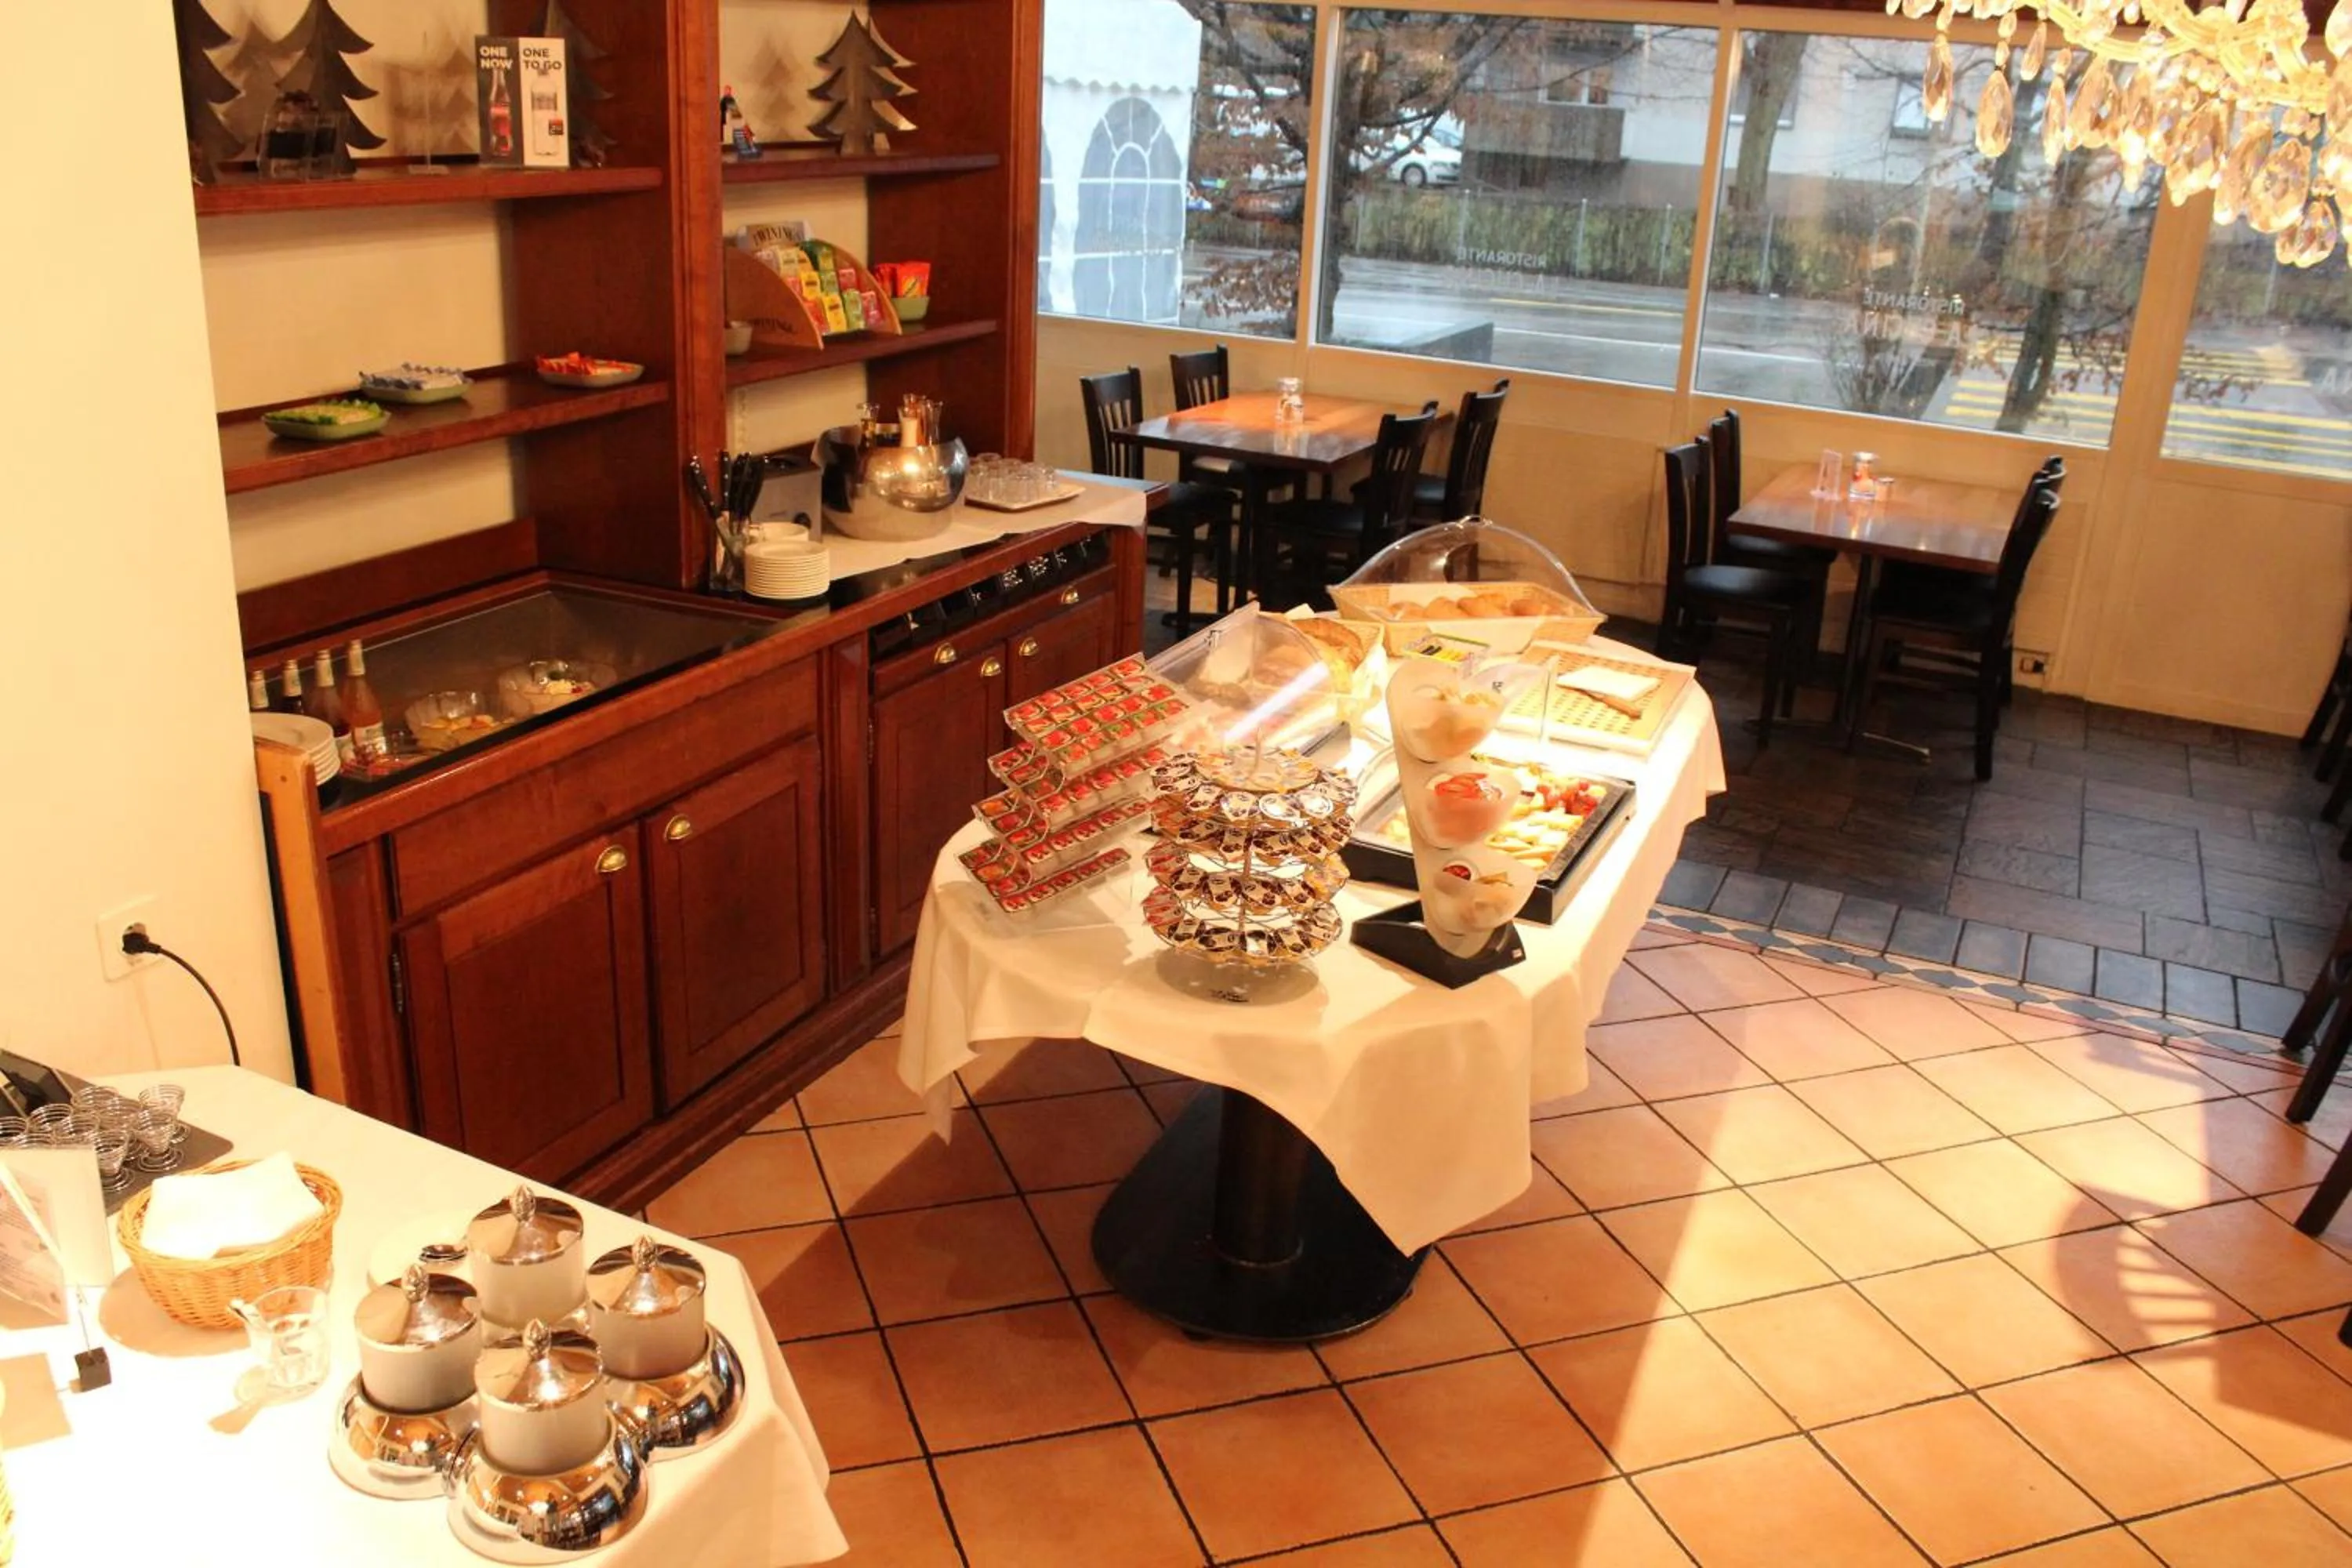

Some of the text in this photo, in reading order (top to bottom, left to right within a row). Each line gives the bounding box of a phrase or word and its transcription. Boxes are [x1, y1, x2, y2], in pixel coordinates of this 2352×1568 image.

[479, 45, 507, 57] ONE
[523, 48, 550, 57] ONE
[480, 58, 513, 70] NOW
[523, 60, 562, 71] TO GO
[752, 223, 806, 247] TWININ
